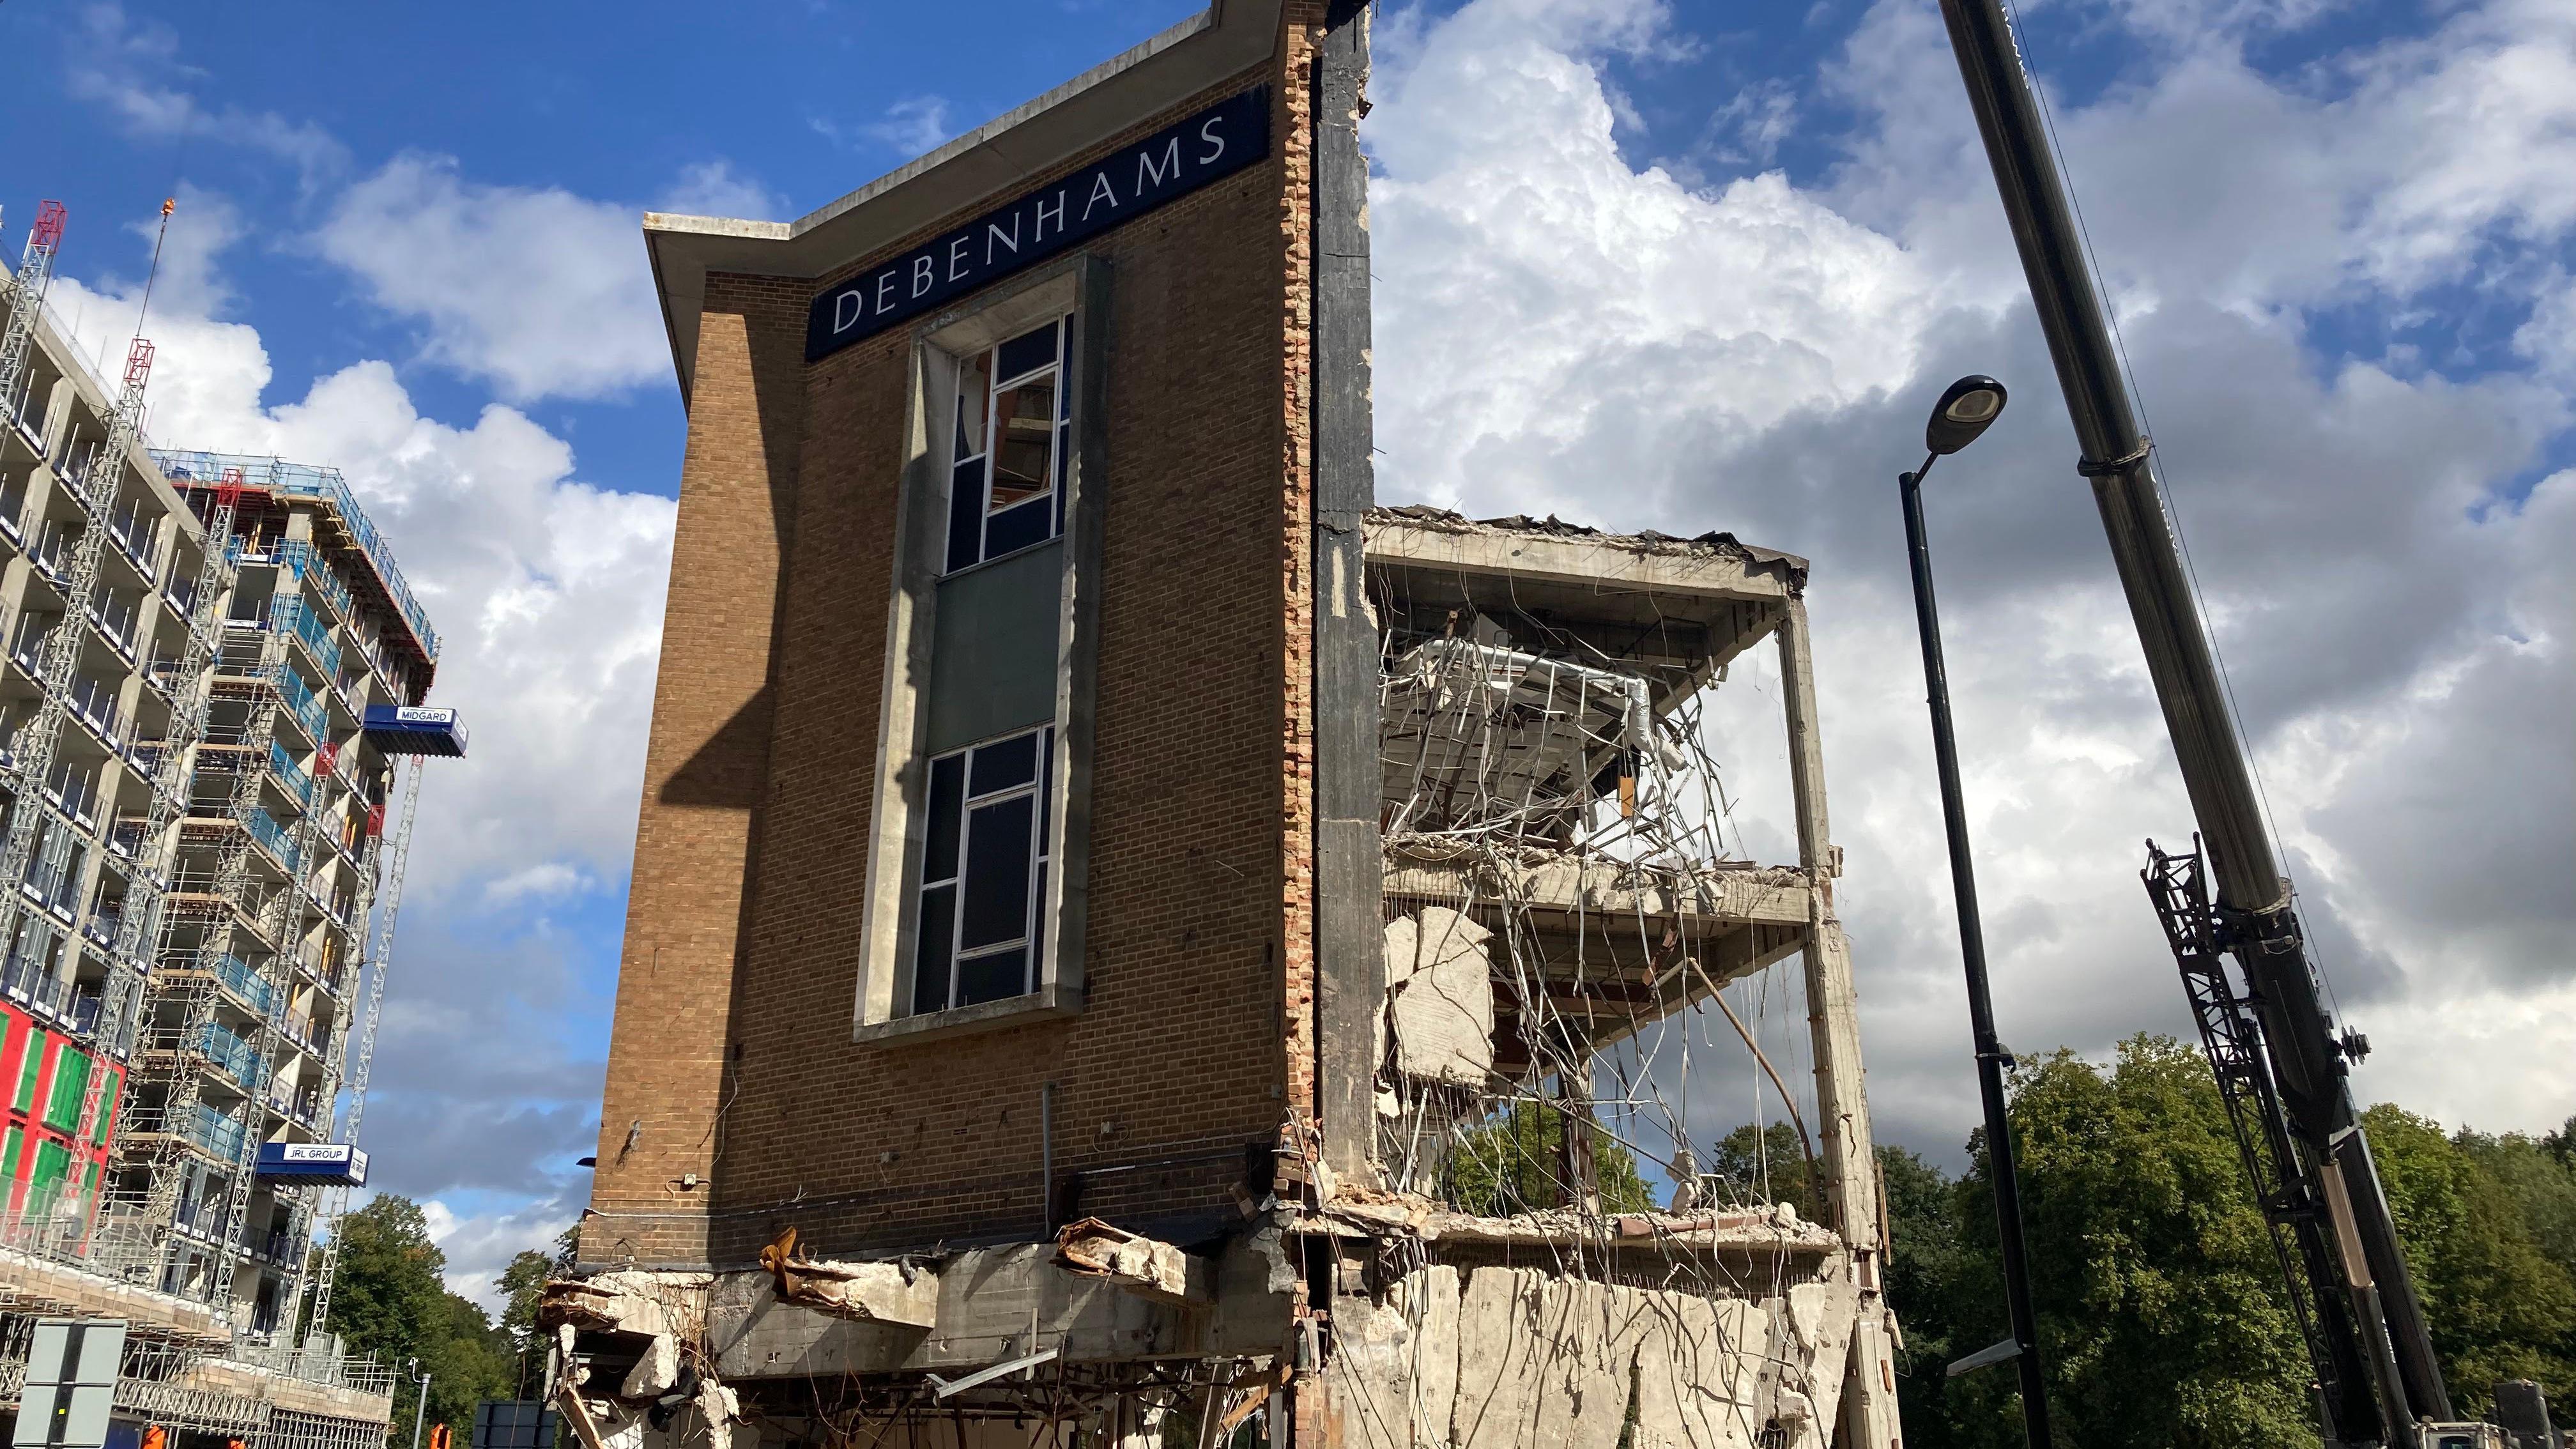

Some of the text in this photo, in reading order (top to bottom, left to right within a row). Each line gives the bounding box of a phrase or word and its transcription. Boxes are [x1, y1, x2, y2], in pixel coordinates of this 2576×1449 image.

[832, 116, 1225, 335] DEBENHAMS
[401, 710, 447, 721] MIDGARD
[290, 1149, 342, 1158] JRL GROUP
